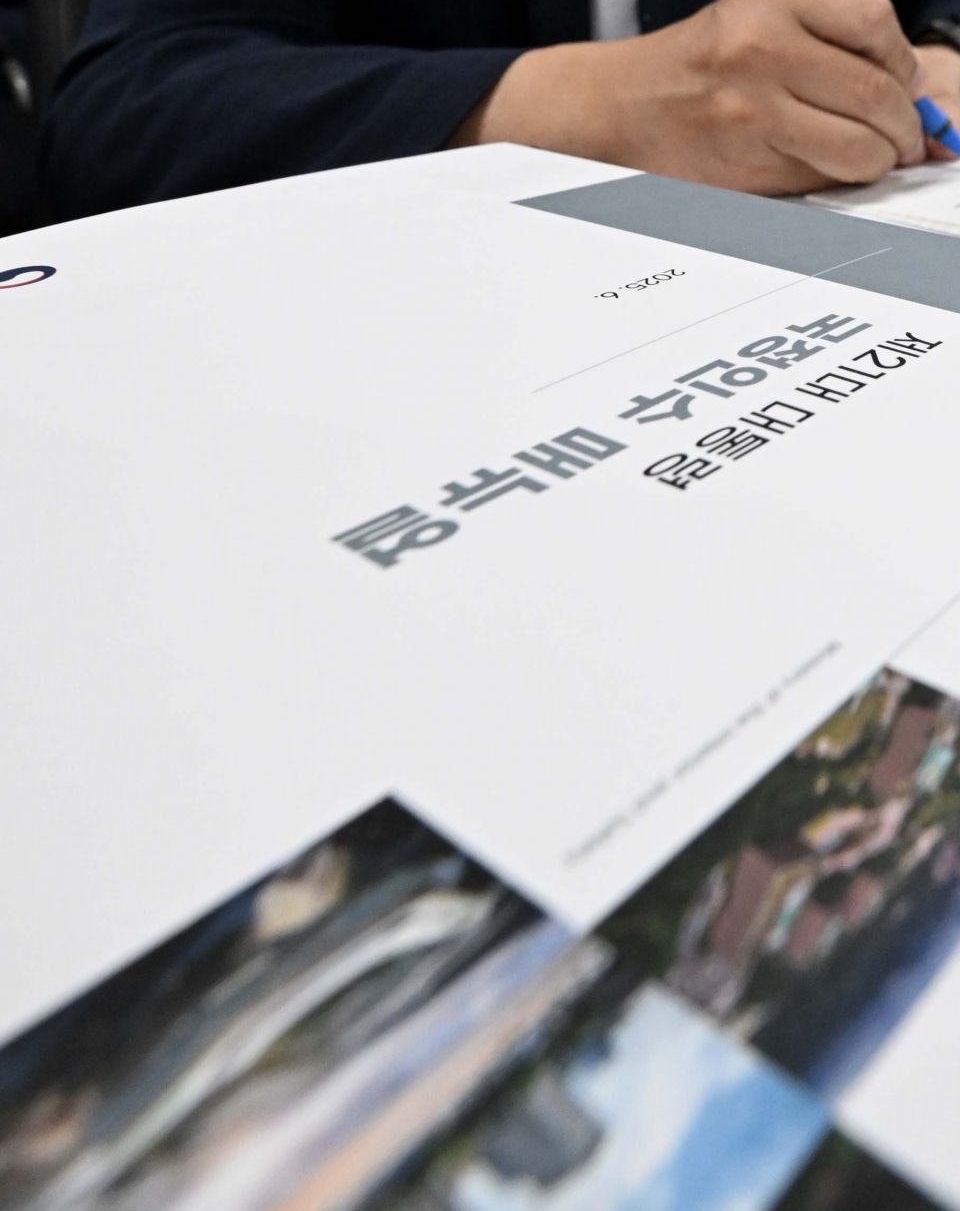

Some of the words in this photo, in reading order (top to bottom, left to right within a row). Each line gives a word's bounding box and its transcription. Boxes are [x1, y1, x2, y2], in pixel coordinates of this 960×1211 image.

[618, 268, 685, 292] 2025.
[617, 314, 873, 425] 국정인수
[796, 332, 943, 403] 제21대
[643, 400, 815, 491] 대통령
[331, 427, 629, 569] 매뉴얼
